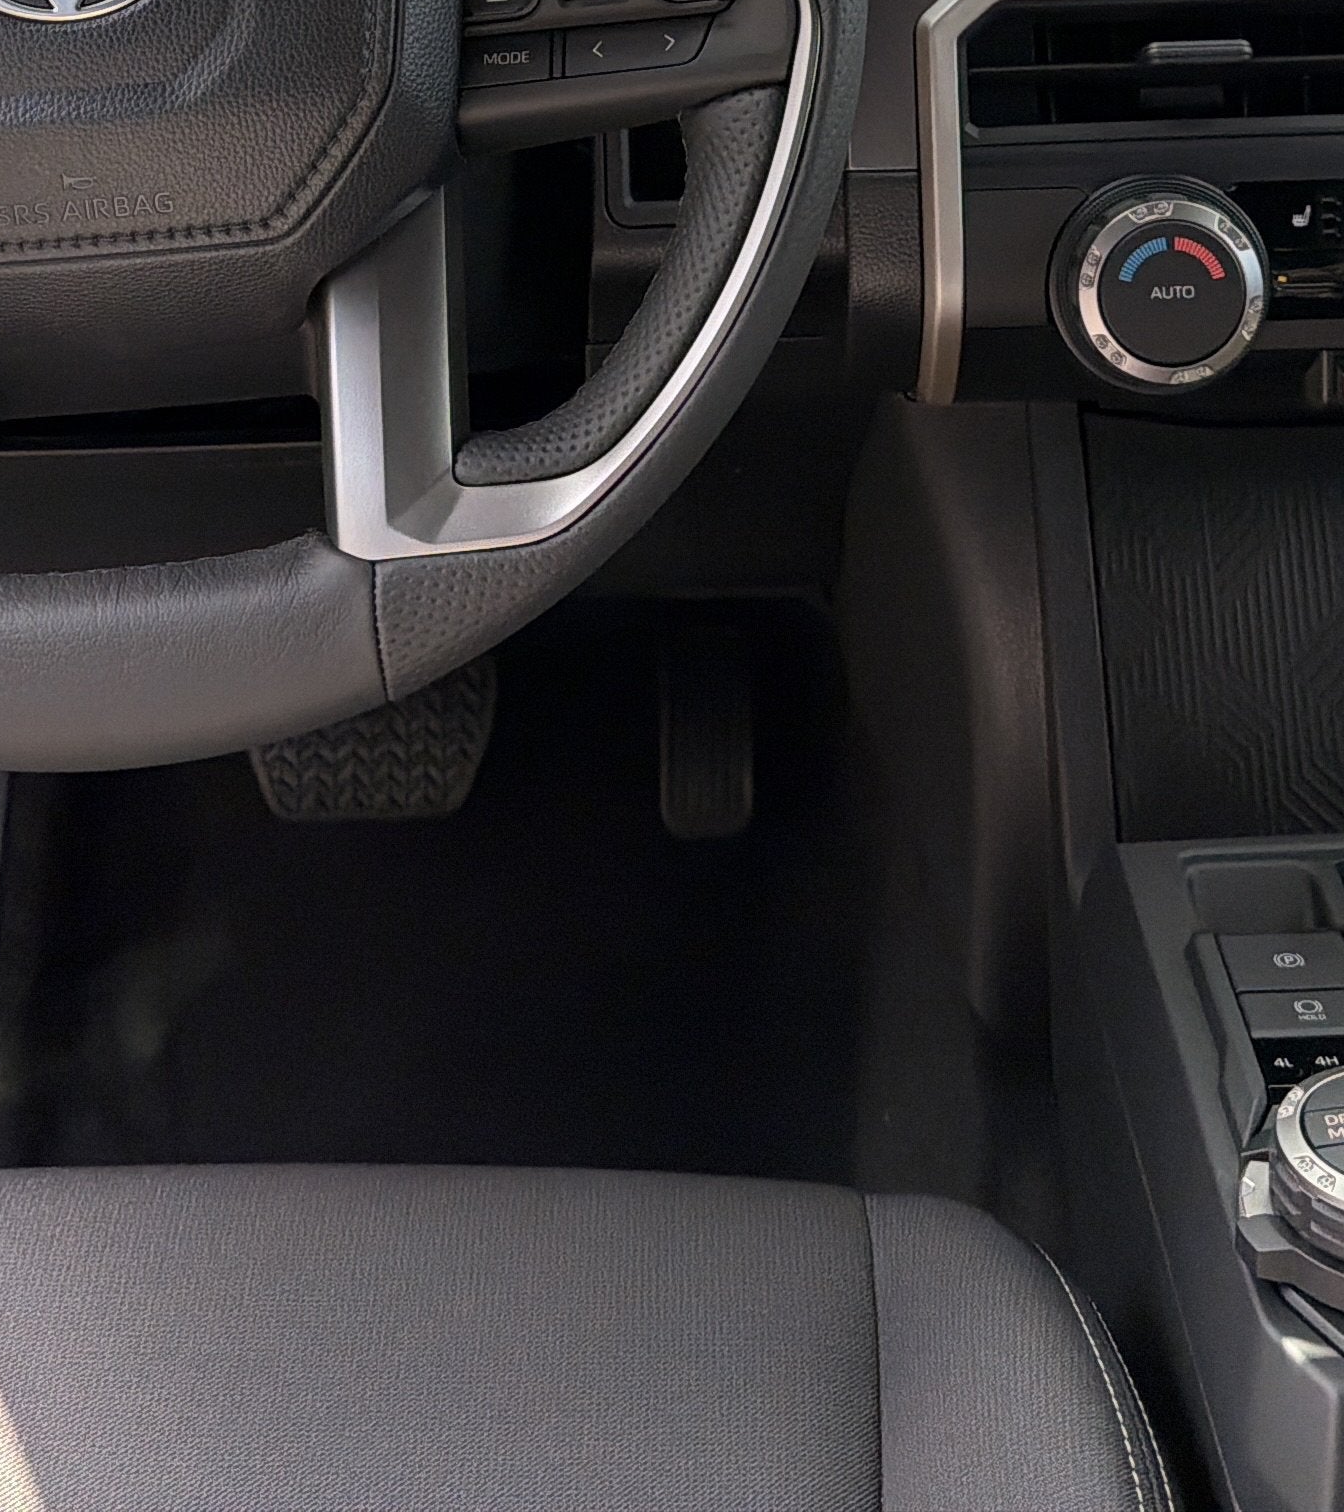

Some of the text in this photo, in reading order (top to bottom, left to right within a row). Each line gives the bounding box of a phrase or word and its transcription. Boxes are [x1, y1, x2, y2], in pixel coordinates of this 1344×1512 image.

[483, 50, 530, 66] MODE
[61, 191, 174, 222] AIRBAG
[1150, 285, 1195, 301] AUTO
[1273, 1057, 1295, 1068] 4L
[1314, 1055, 1340, 1066] 4H
